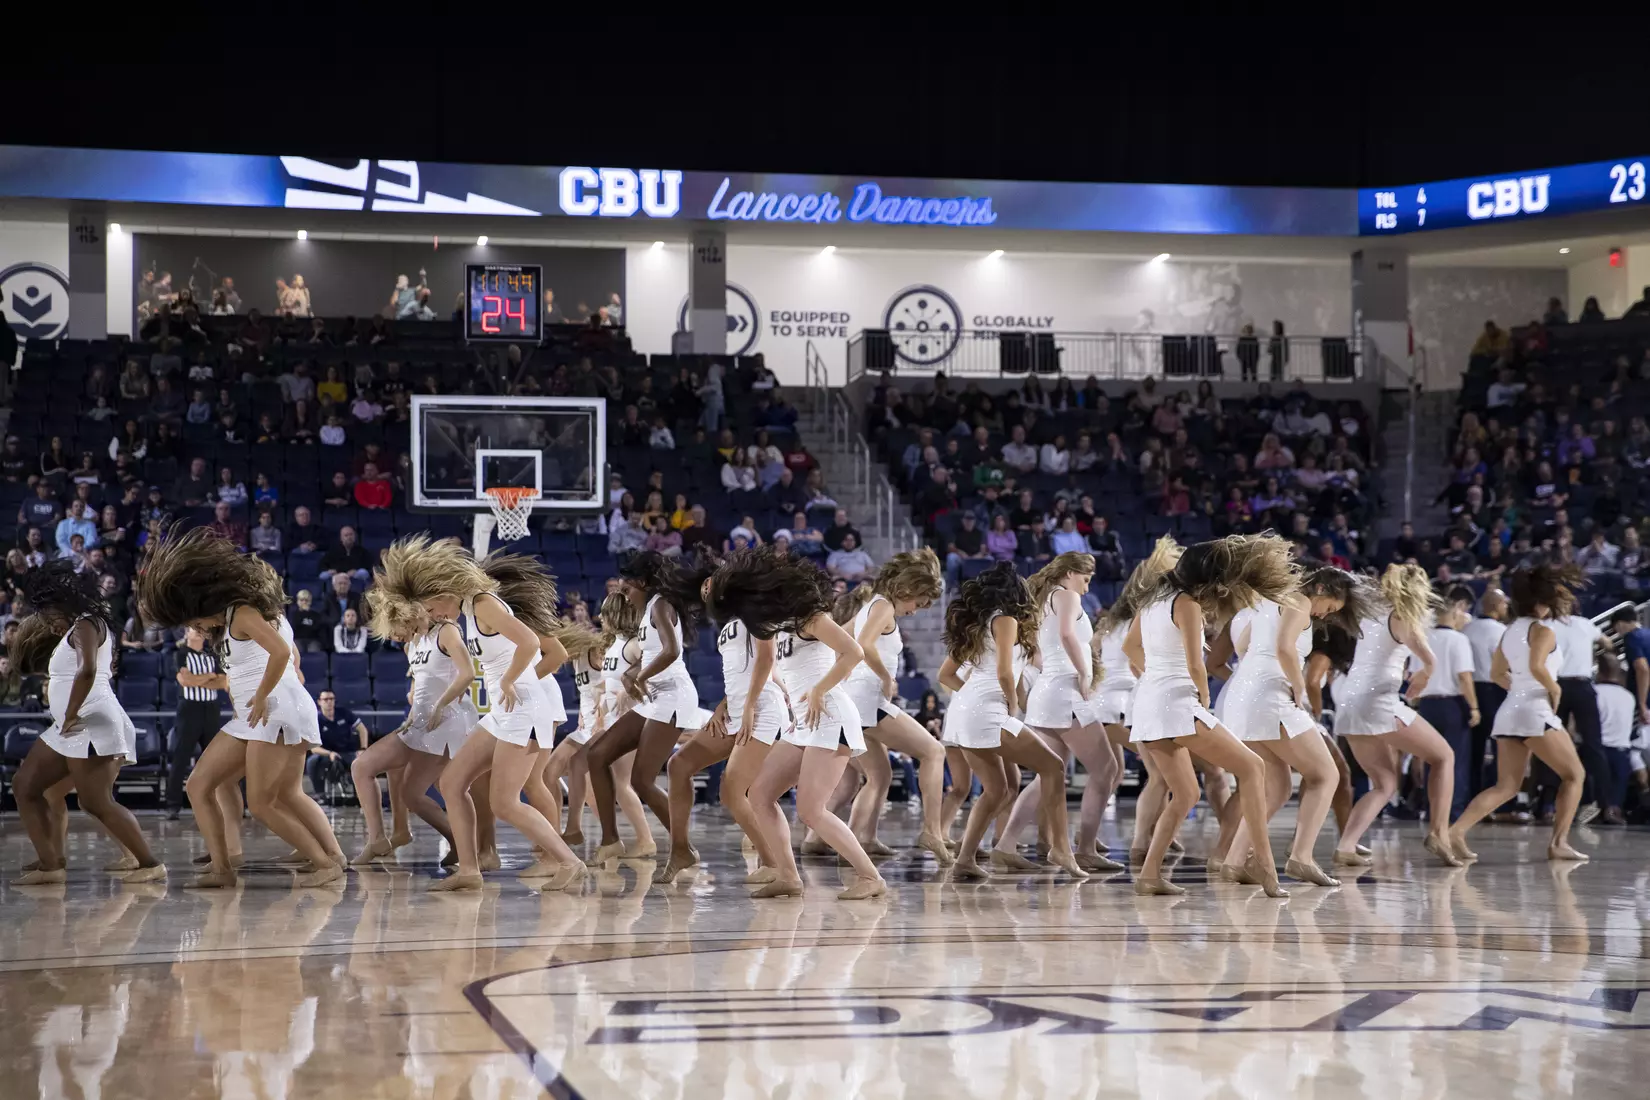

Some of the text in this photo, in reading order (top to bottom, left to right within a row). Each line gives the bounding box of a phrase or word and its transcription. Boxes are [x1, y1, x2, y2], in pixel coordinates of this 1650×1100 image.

[559, 166, 683, 218] CBU
[707, 177, 998, 226] Lancer Dancers
[1374, 187, 1427, 209] TOL 4
[1467, 162, 1646, 220] CBU 23
[1375, 208, 1427, 229] FLS 7
[481, 295, 526, 333] 24
[770, 310, 850, 324] EQUIPPED
[973, 315, 1055, 329] GLOBALLY
[770, 325, 848, 338] TO SERVE
